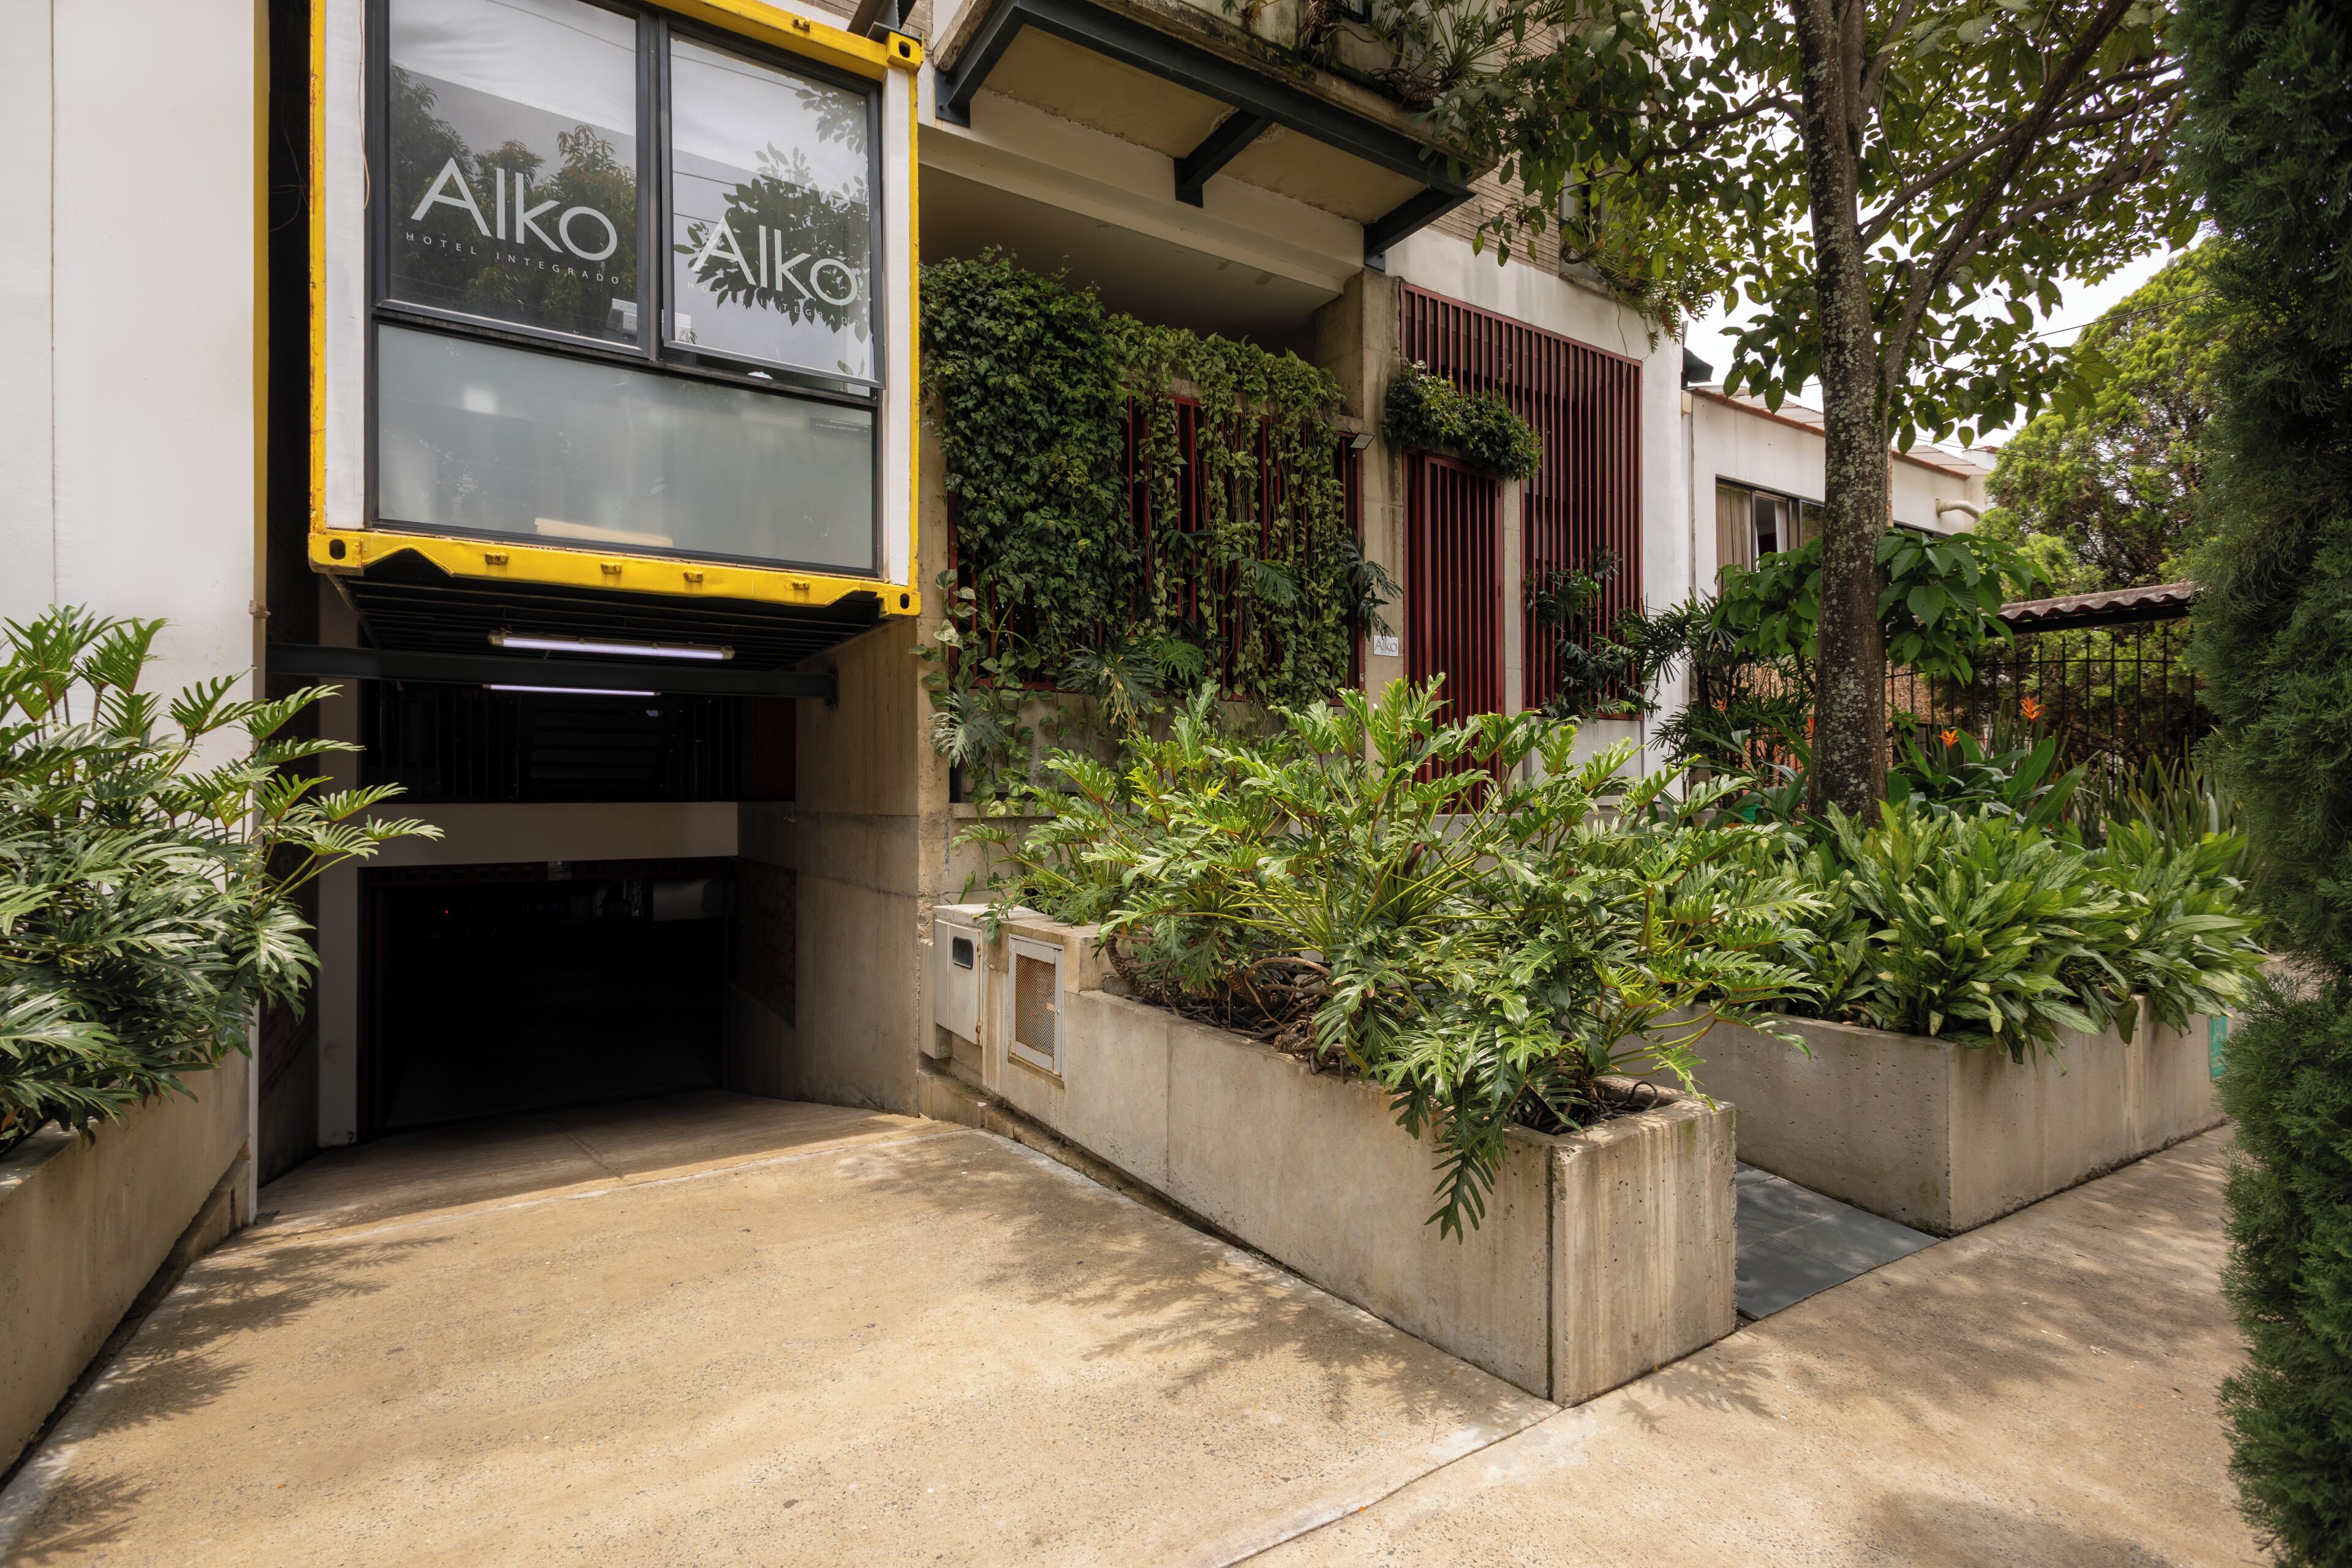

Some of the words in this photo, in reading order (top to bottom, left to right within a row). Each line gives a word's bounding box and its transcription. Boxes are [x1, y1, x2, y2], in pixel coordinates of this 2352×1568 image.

[410, 157, 617, 261] Alko
[406, 232, 477, 255] HOTEL
[496, 252, 619, 284] INTEGRADO
[691, 216, 858, 306] Alko
[687, 281, 744, 301] HOTEL
[760, 298, 860, 326] INTEGRADO
